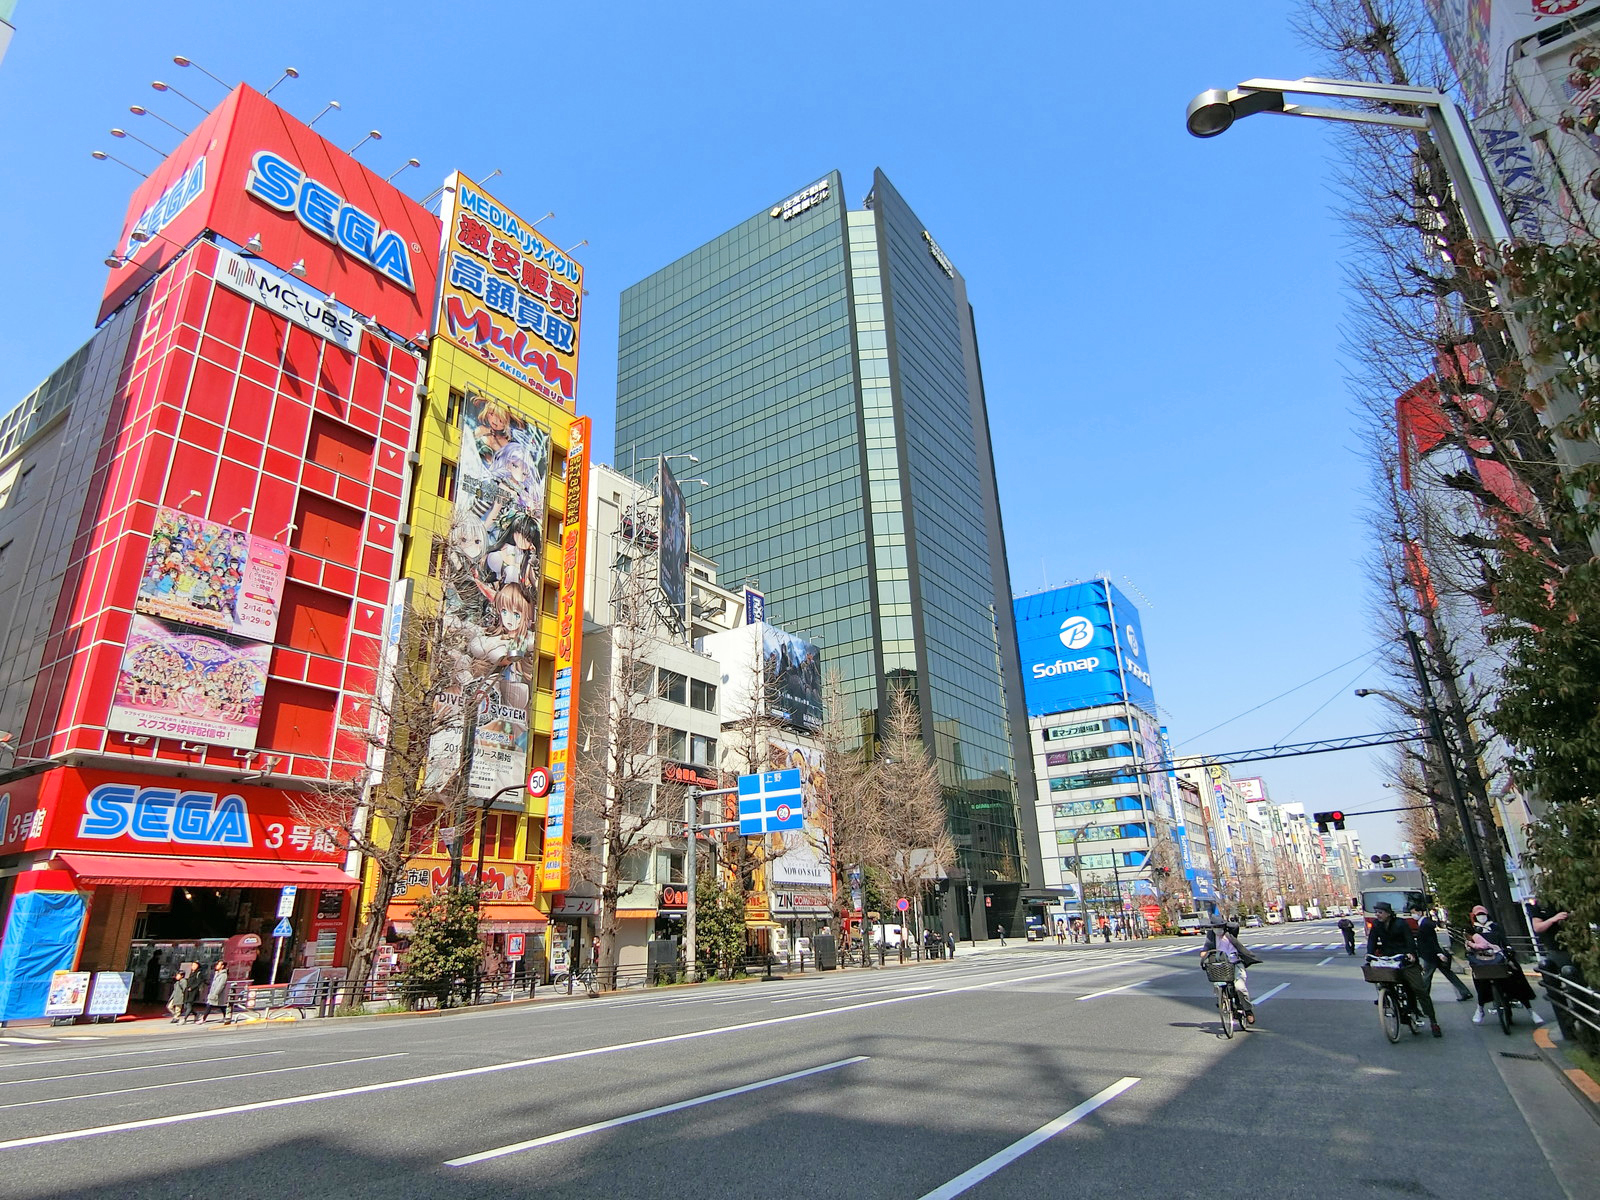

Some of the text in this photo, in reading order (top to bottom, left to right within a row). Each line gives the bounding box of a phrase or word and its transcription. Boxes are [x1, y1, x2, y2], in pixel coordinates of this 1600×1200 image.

[245, 150, 416, 293] SEGA
[458, 214, 576, 316] 激安販売
[259, 275, 353, 338] MC-UBS
[261, 293, 350, 342] GROUP
[451, 253, 574, 351] 高額買取
[447, 296, 574, 399] Mulan
[458, 336, 500, 363] ムーラン
[500, 360, 527, 382] AKIBA
[559, 530, 578, 662] お売り下さい
[1032, 656, 1100, 679] Sofmap
[490, 704, 526, 721] SYSTEM
[532, 775, 545, 789] 50
[765, 773, 782, 784] 上野
[8, 807, 47, 843] 3号館
[77, 783, 253, 847] SEGA
[265, 823, 338, 852] 3号館
[798, 868, 807, 876] ON
[807, 869, 822, 878] SALE
[777, 892, 792, 909] ZIN
